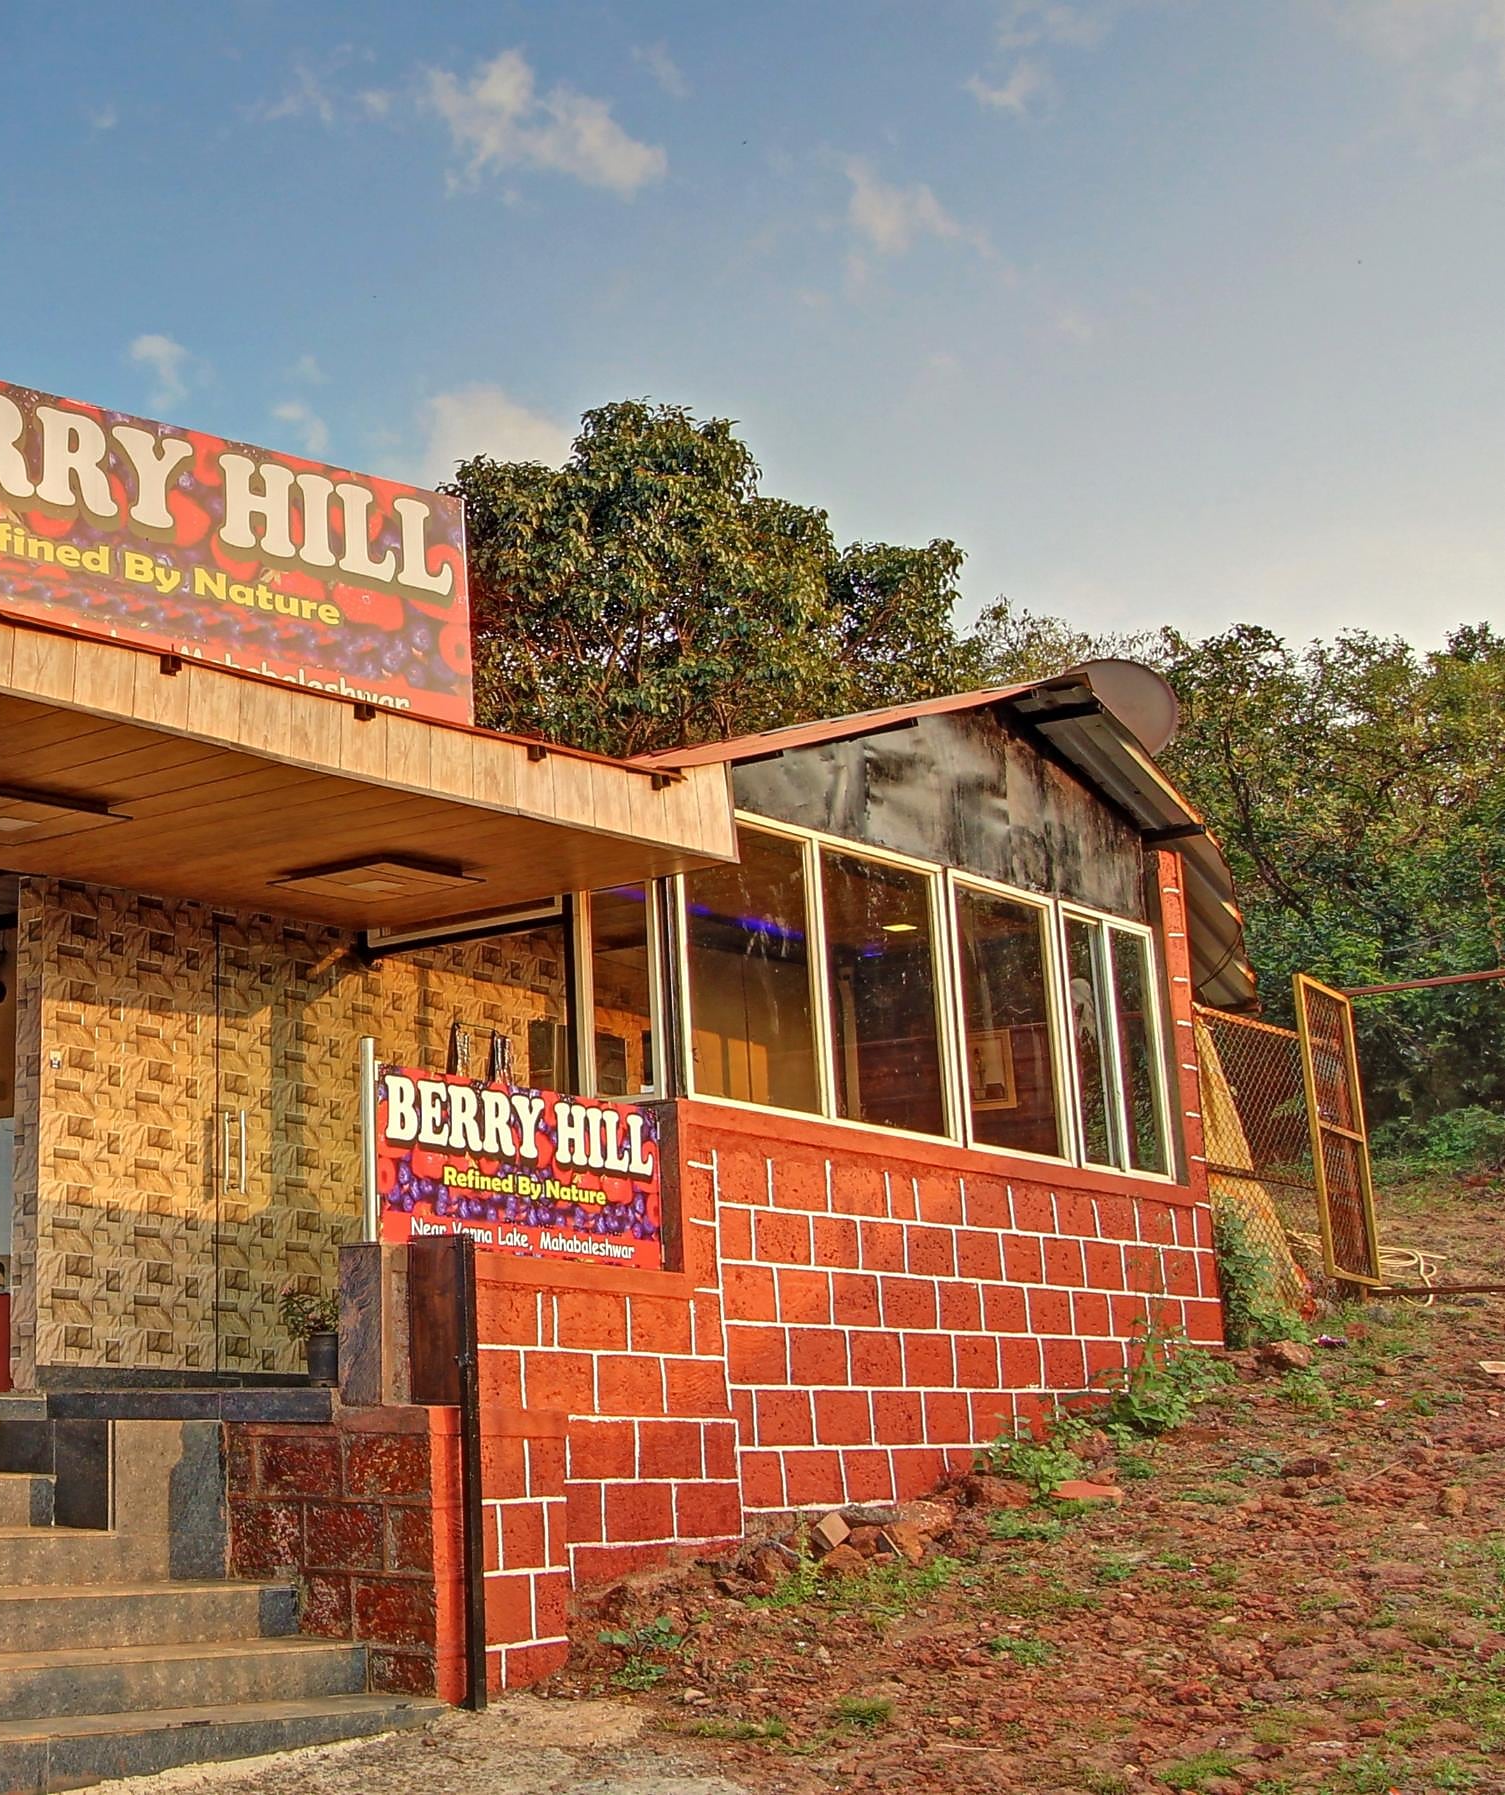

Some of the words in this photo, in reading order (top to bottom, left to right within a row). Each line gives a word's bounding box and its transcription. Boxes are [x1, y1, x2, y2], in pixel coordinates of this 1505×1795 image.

[219, 452, 454, 597] HILL
[124, 551, 181, 594] By
[194, 567, 341, 625] Nature
[385, 1074, 544, 1159] BERRY
[553, 1101, 654, 1177] HILL
[443, 1166, 514, 1193] Refined
[518, 1176, 542, 1200] By
[545, 1179, 607, 1205] Nature
[497, 1226, 535, 1251] Lake,
[539, 1231, 635, 1259] Mahabaleshwar
